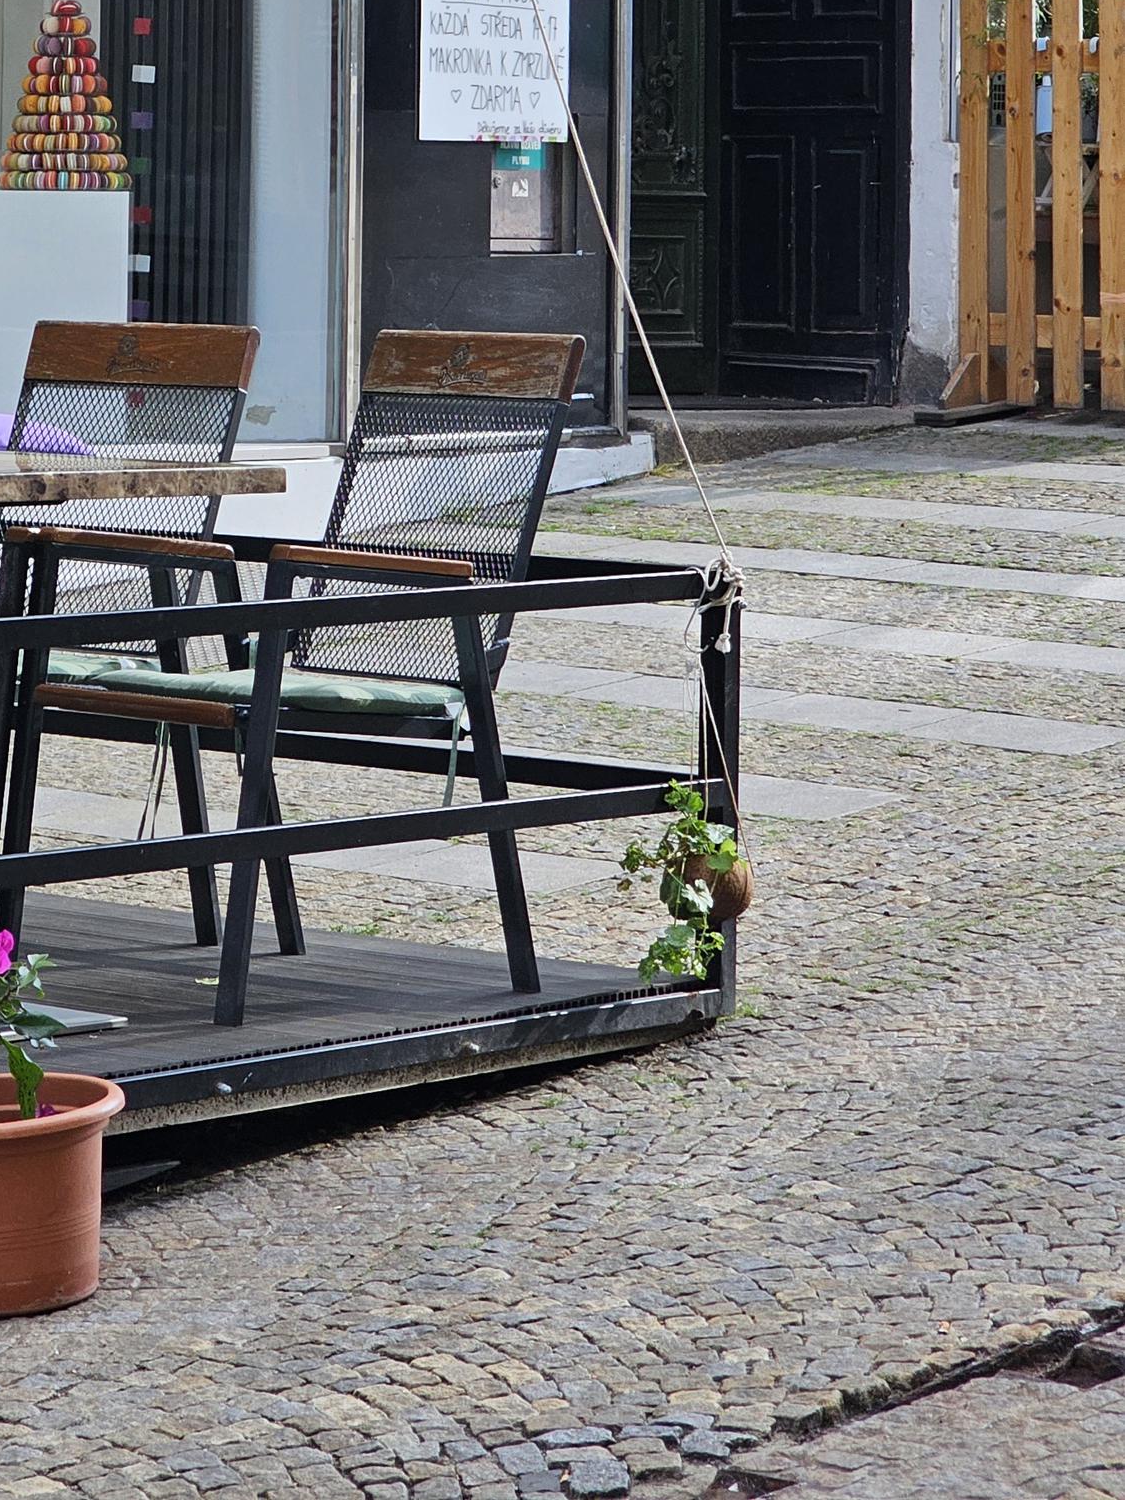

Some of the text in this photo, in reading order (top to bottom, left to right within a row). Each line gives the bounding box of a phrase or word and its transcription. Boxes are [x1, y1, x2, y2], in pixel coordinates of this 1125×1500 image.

[430, 5, 470, 36] KAŽDÁ
[481, 10, 523, 40] STŘEDA
[429, 47, 492, 76] MAKRONKA
[500, 51, 508, 77] K
[470, 84, 522, 114] ZDARMA
